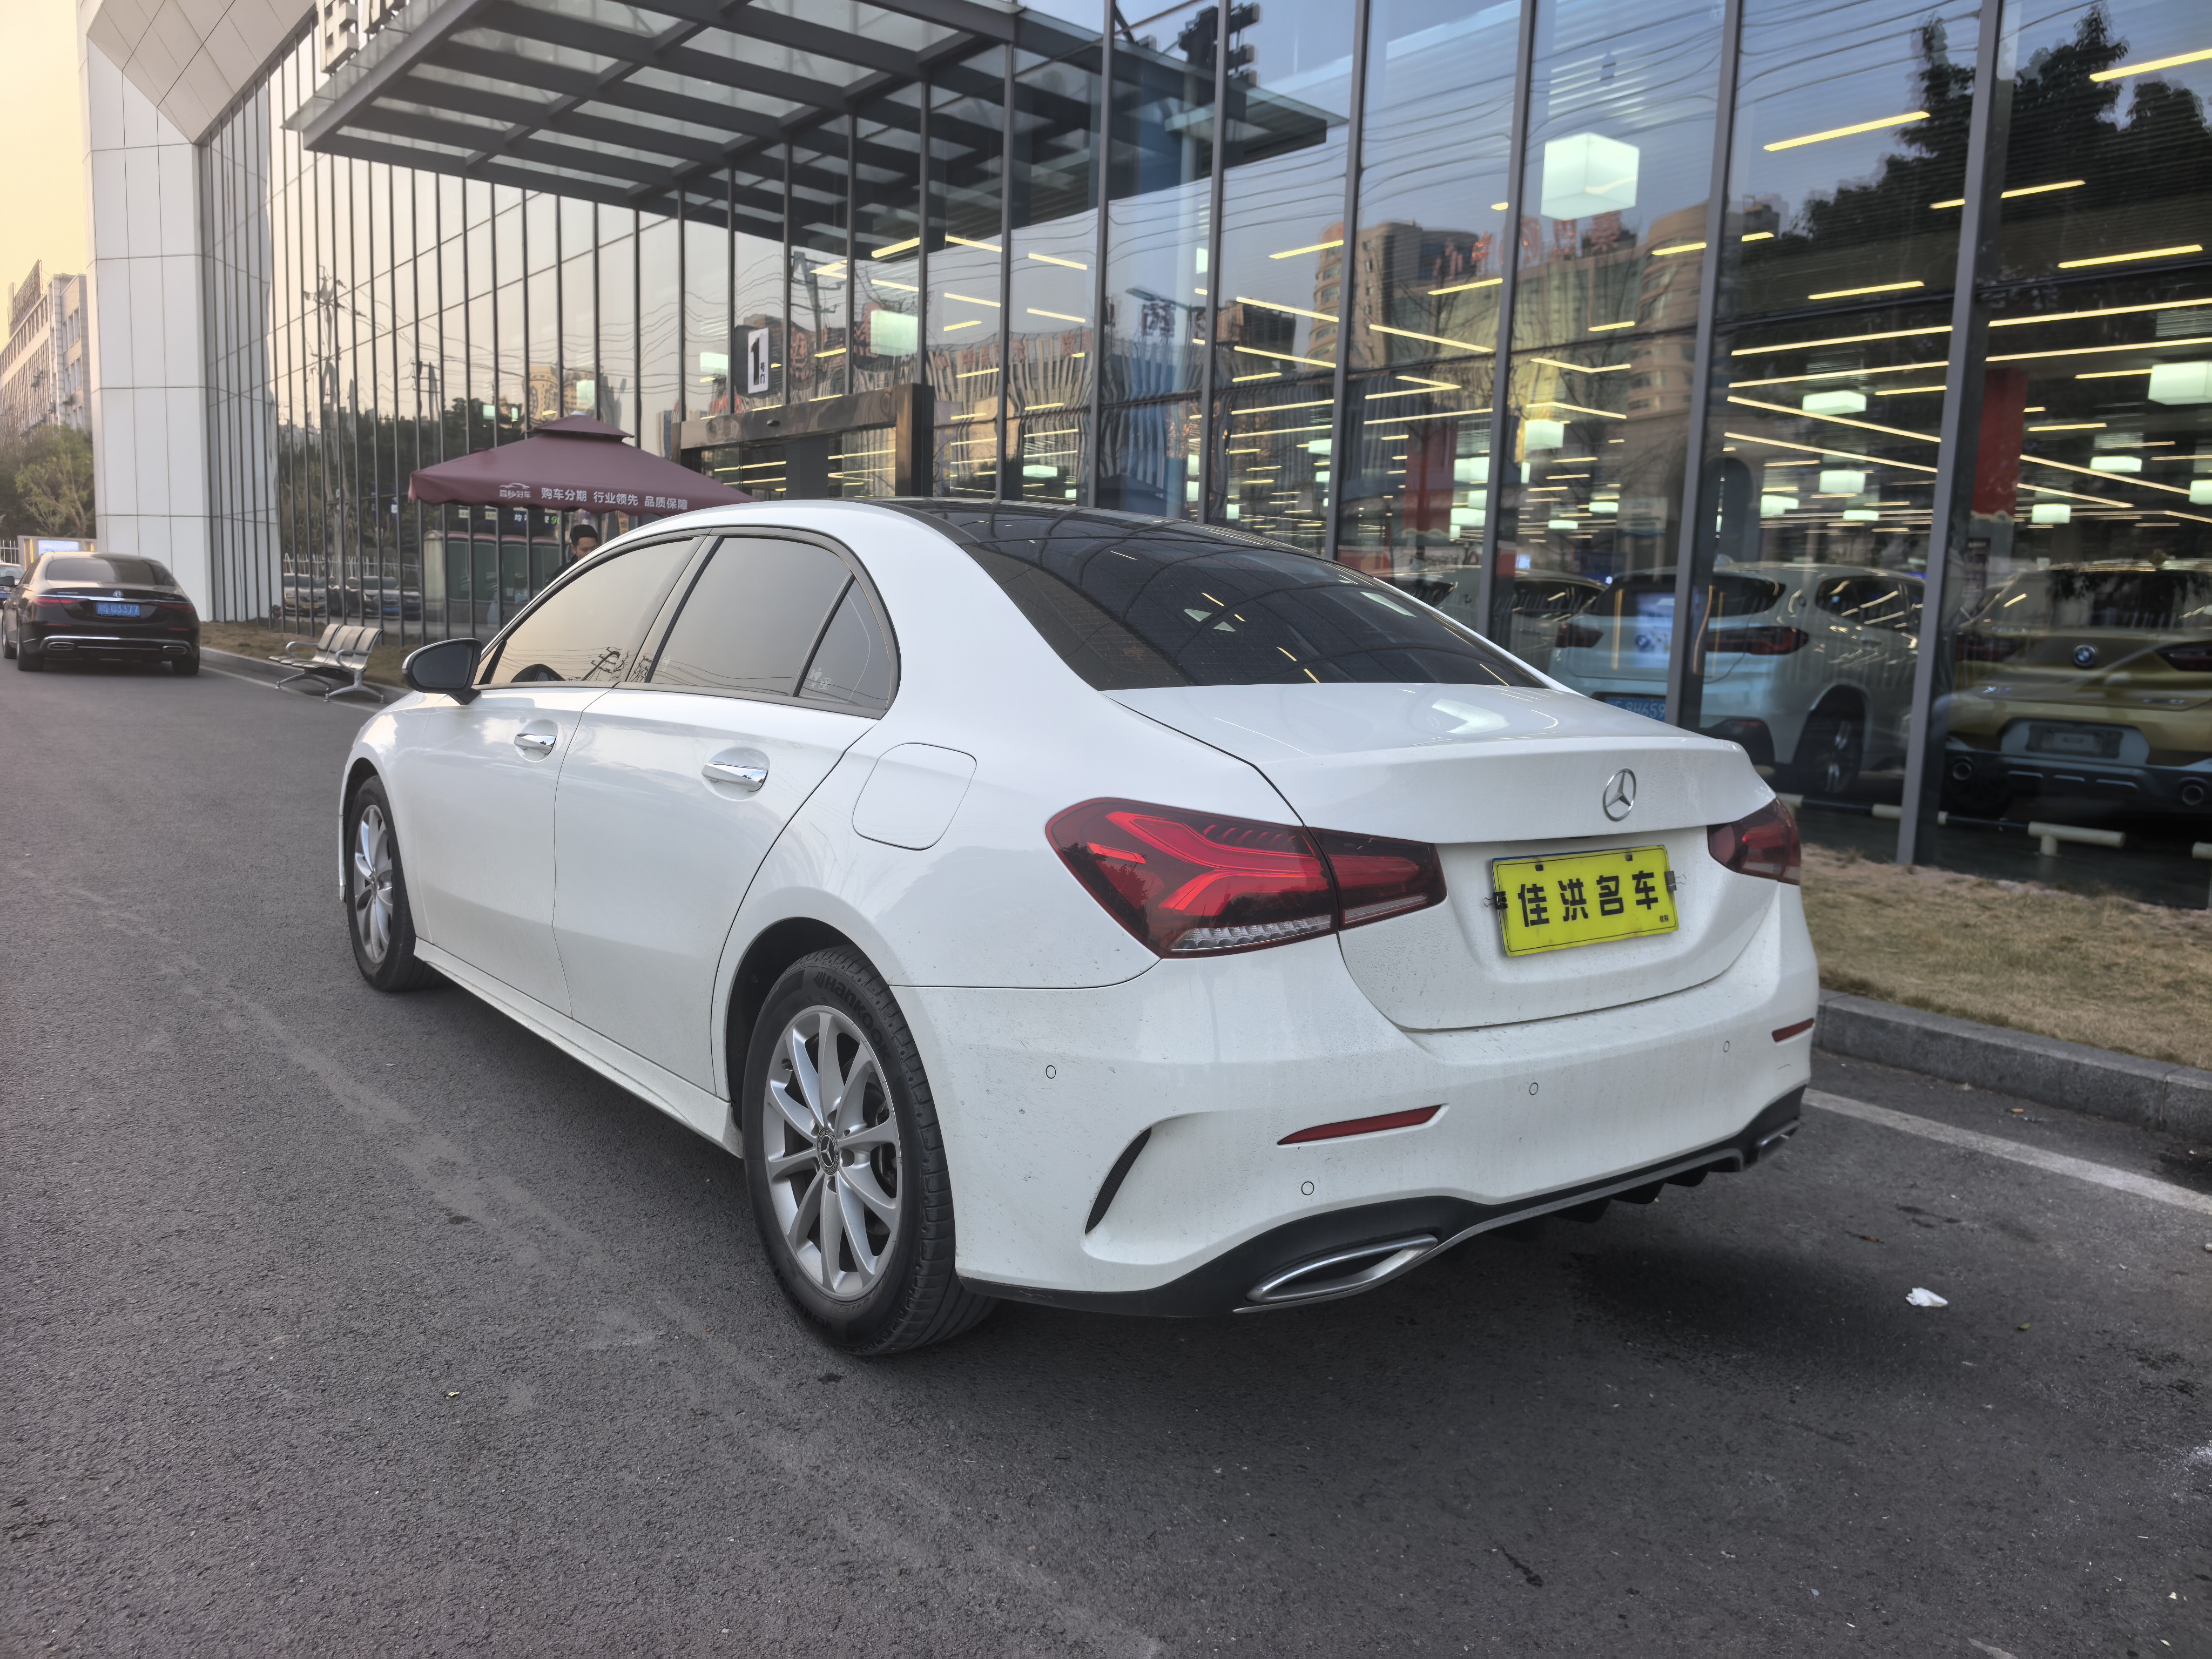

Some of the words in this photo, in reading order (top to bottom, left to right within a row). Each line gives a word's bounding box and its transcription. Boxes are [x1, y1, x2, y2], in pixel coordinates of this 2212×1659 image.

[541, 487, 587, 502] 购车分期
[593, 491, 638, 506] 行业领先
[644, 495, 688, 510] 品质保障
[1518, 870, 1658, 927] 佳洪名车
